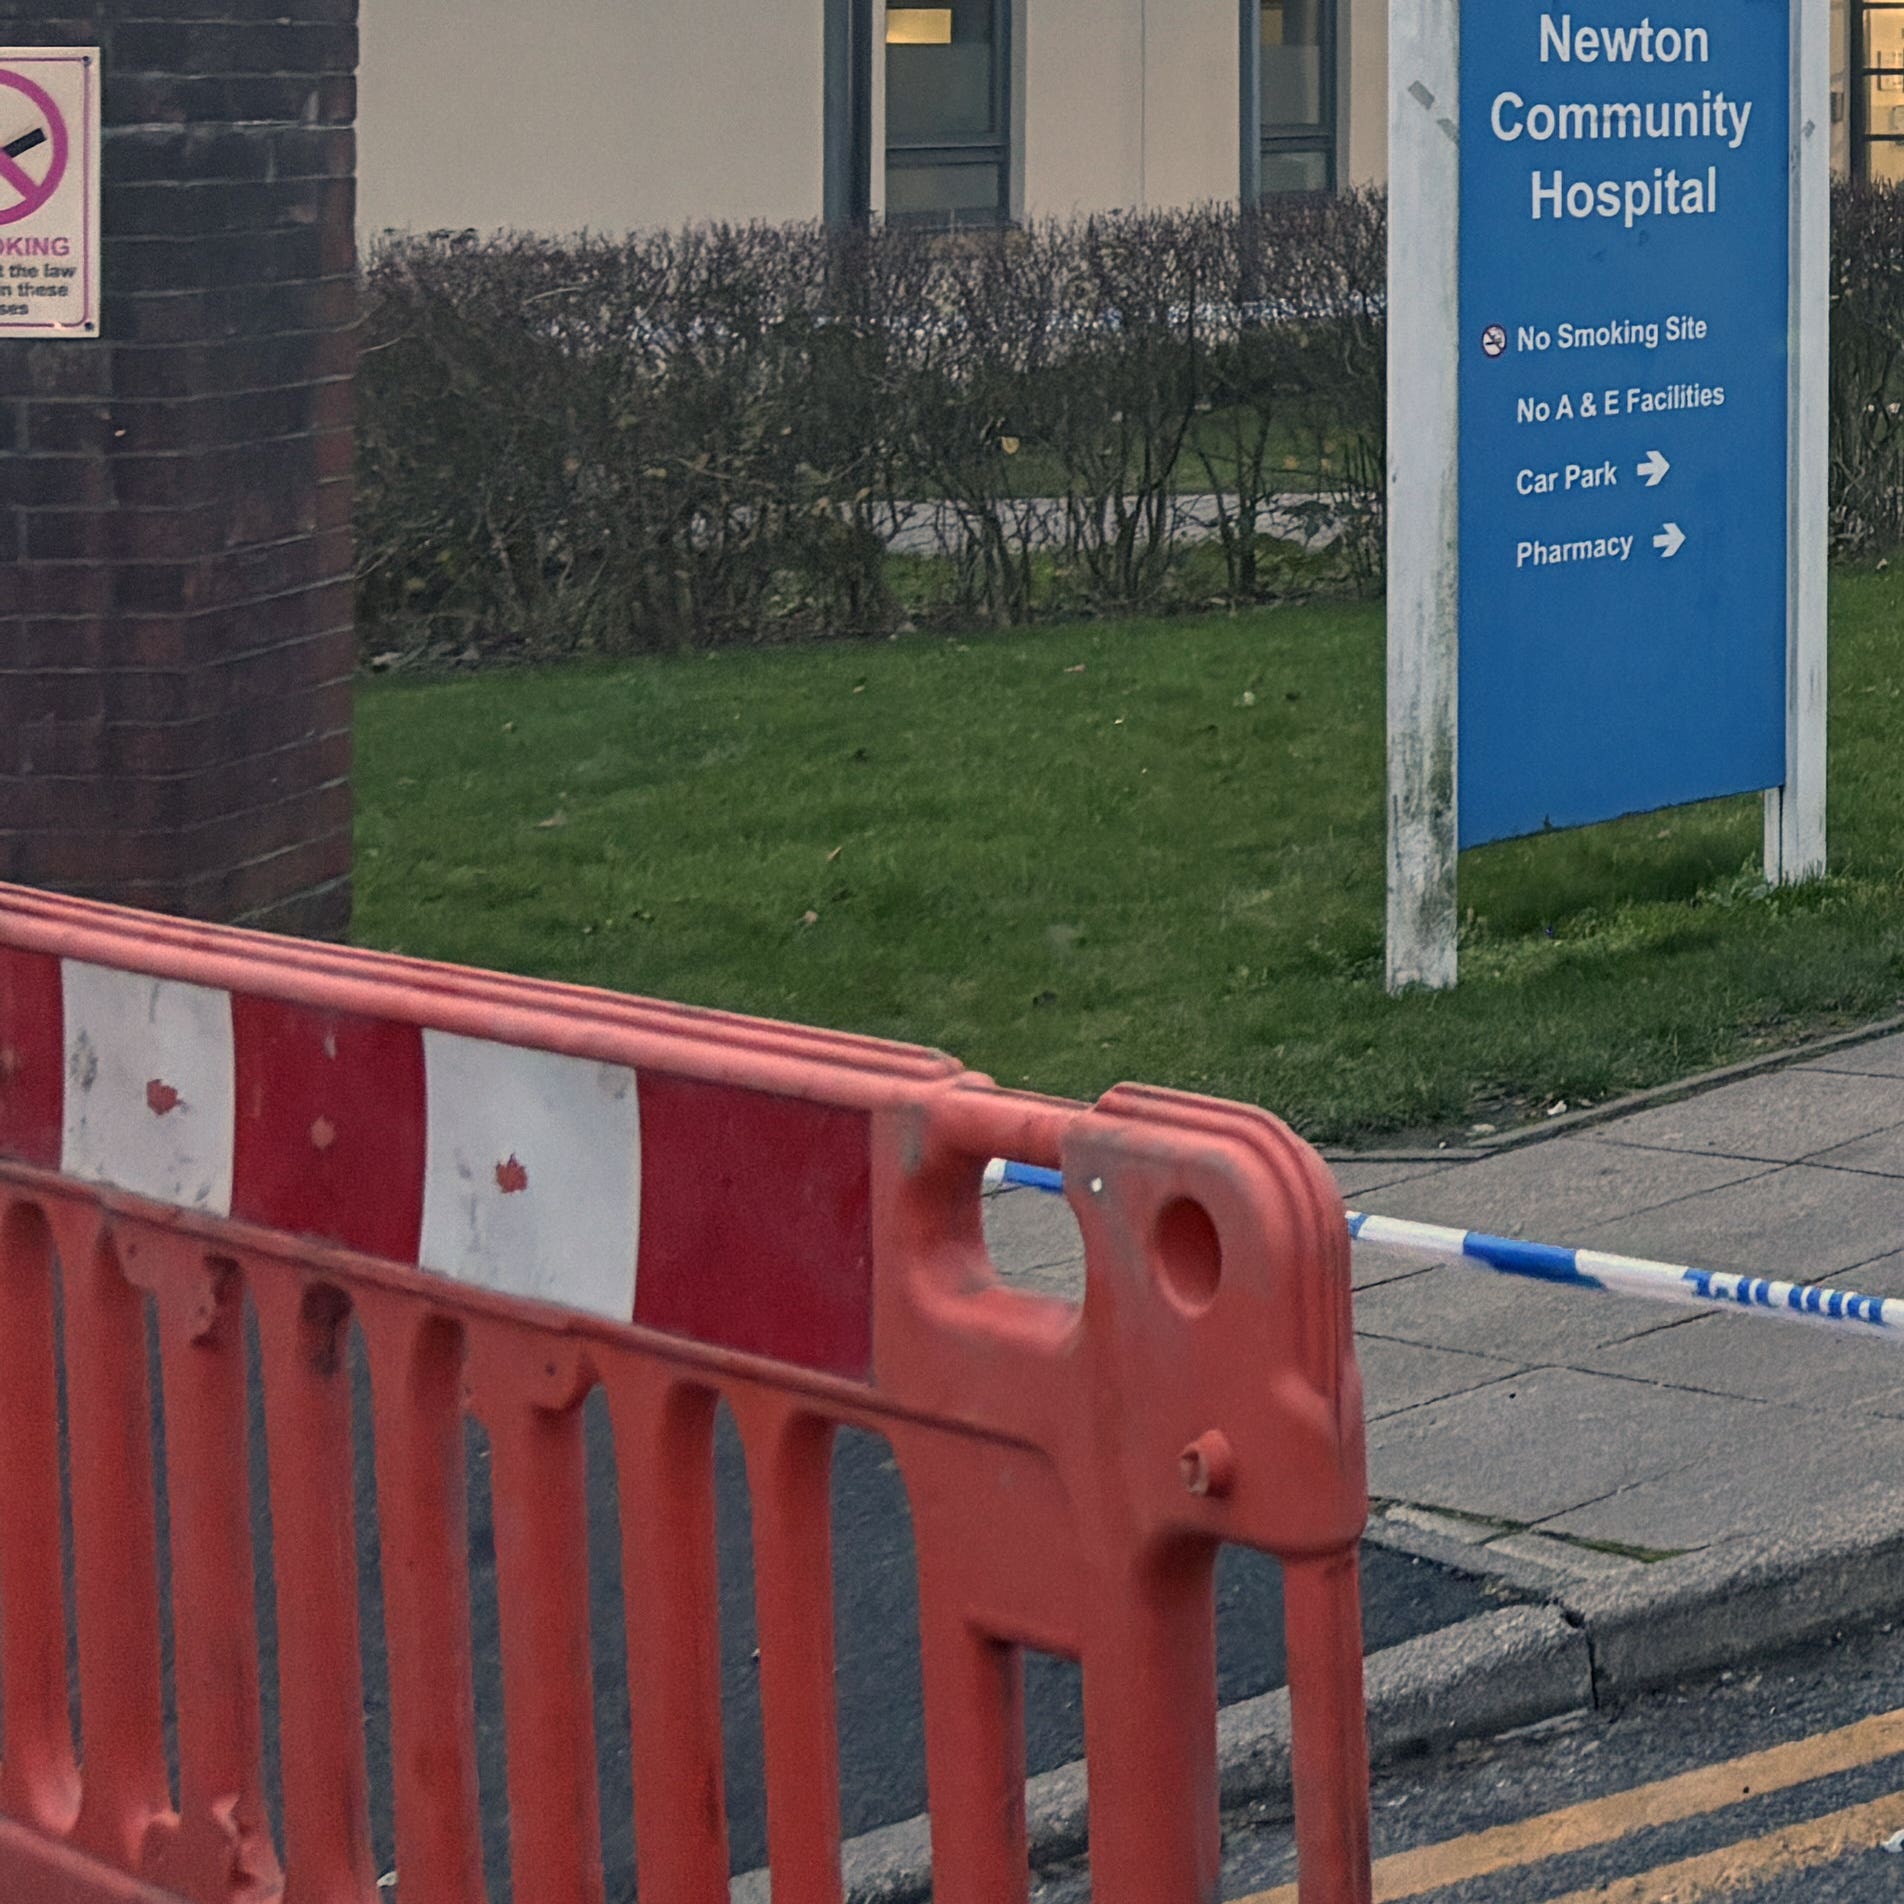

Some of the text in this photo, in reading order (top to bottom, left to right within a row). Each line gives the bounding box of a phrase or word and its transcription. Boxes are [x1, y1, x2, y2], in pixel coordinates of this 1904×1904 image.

[1540, 14, 1709, 63] Newton
[1490, 90, 1752, 149] Community
[1531, 166, 1716, 228] Hospital
[9, 264, 39, 278] the
[44, 263, 78, 278] law
[17, 282, 69, 297] these
[1517, 315, 1708, 352] No Smoking Site
[1517, 383, 1725, 423] No A & E Facilities
[1516, 461, 1617, 495] Car Park
[1517, 535, 1633, 568] Pharmacy
